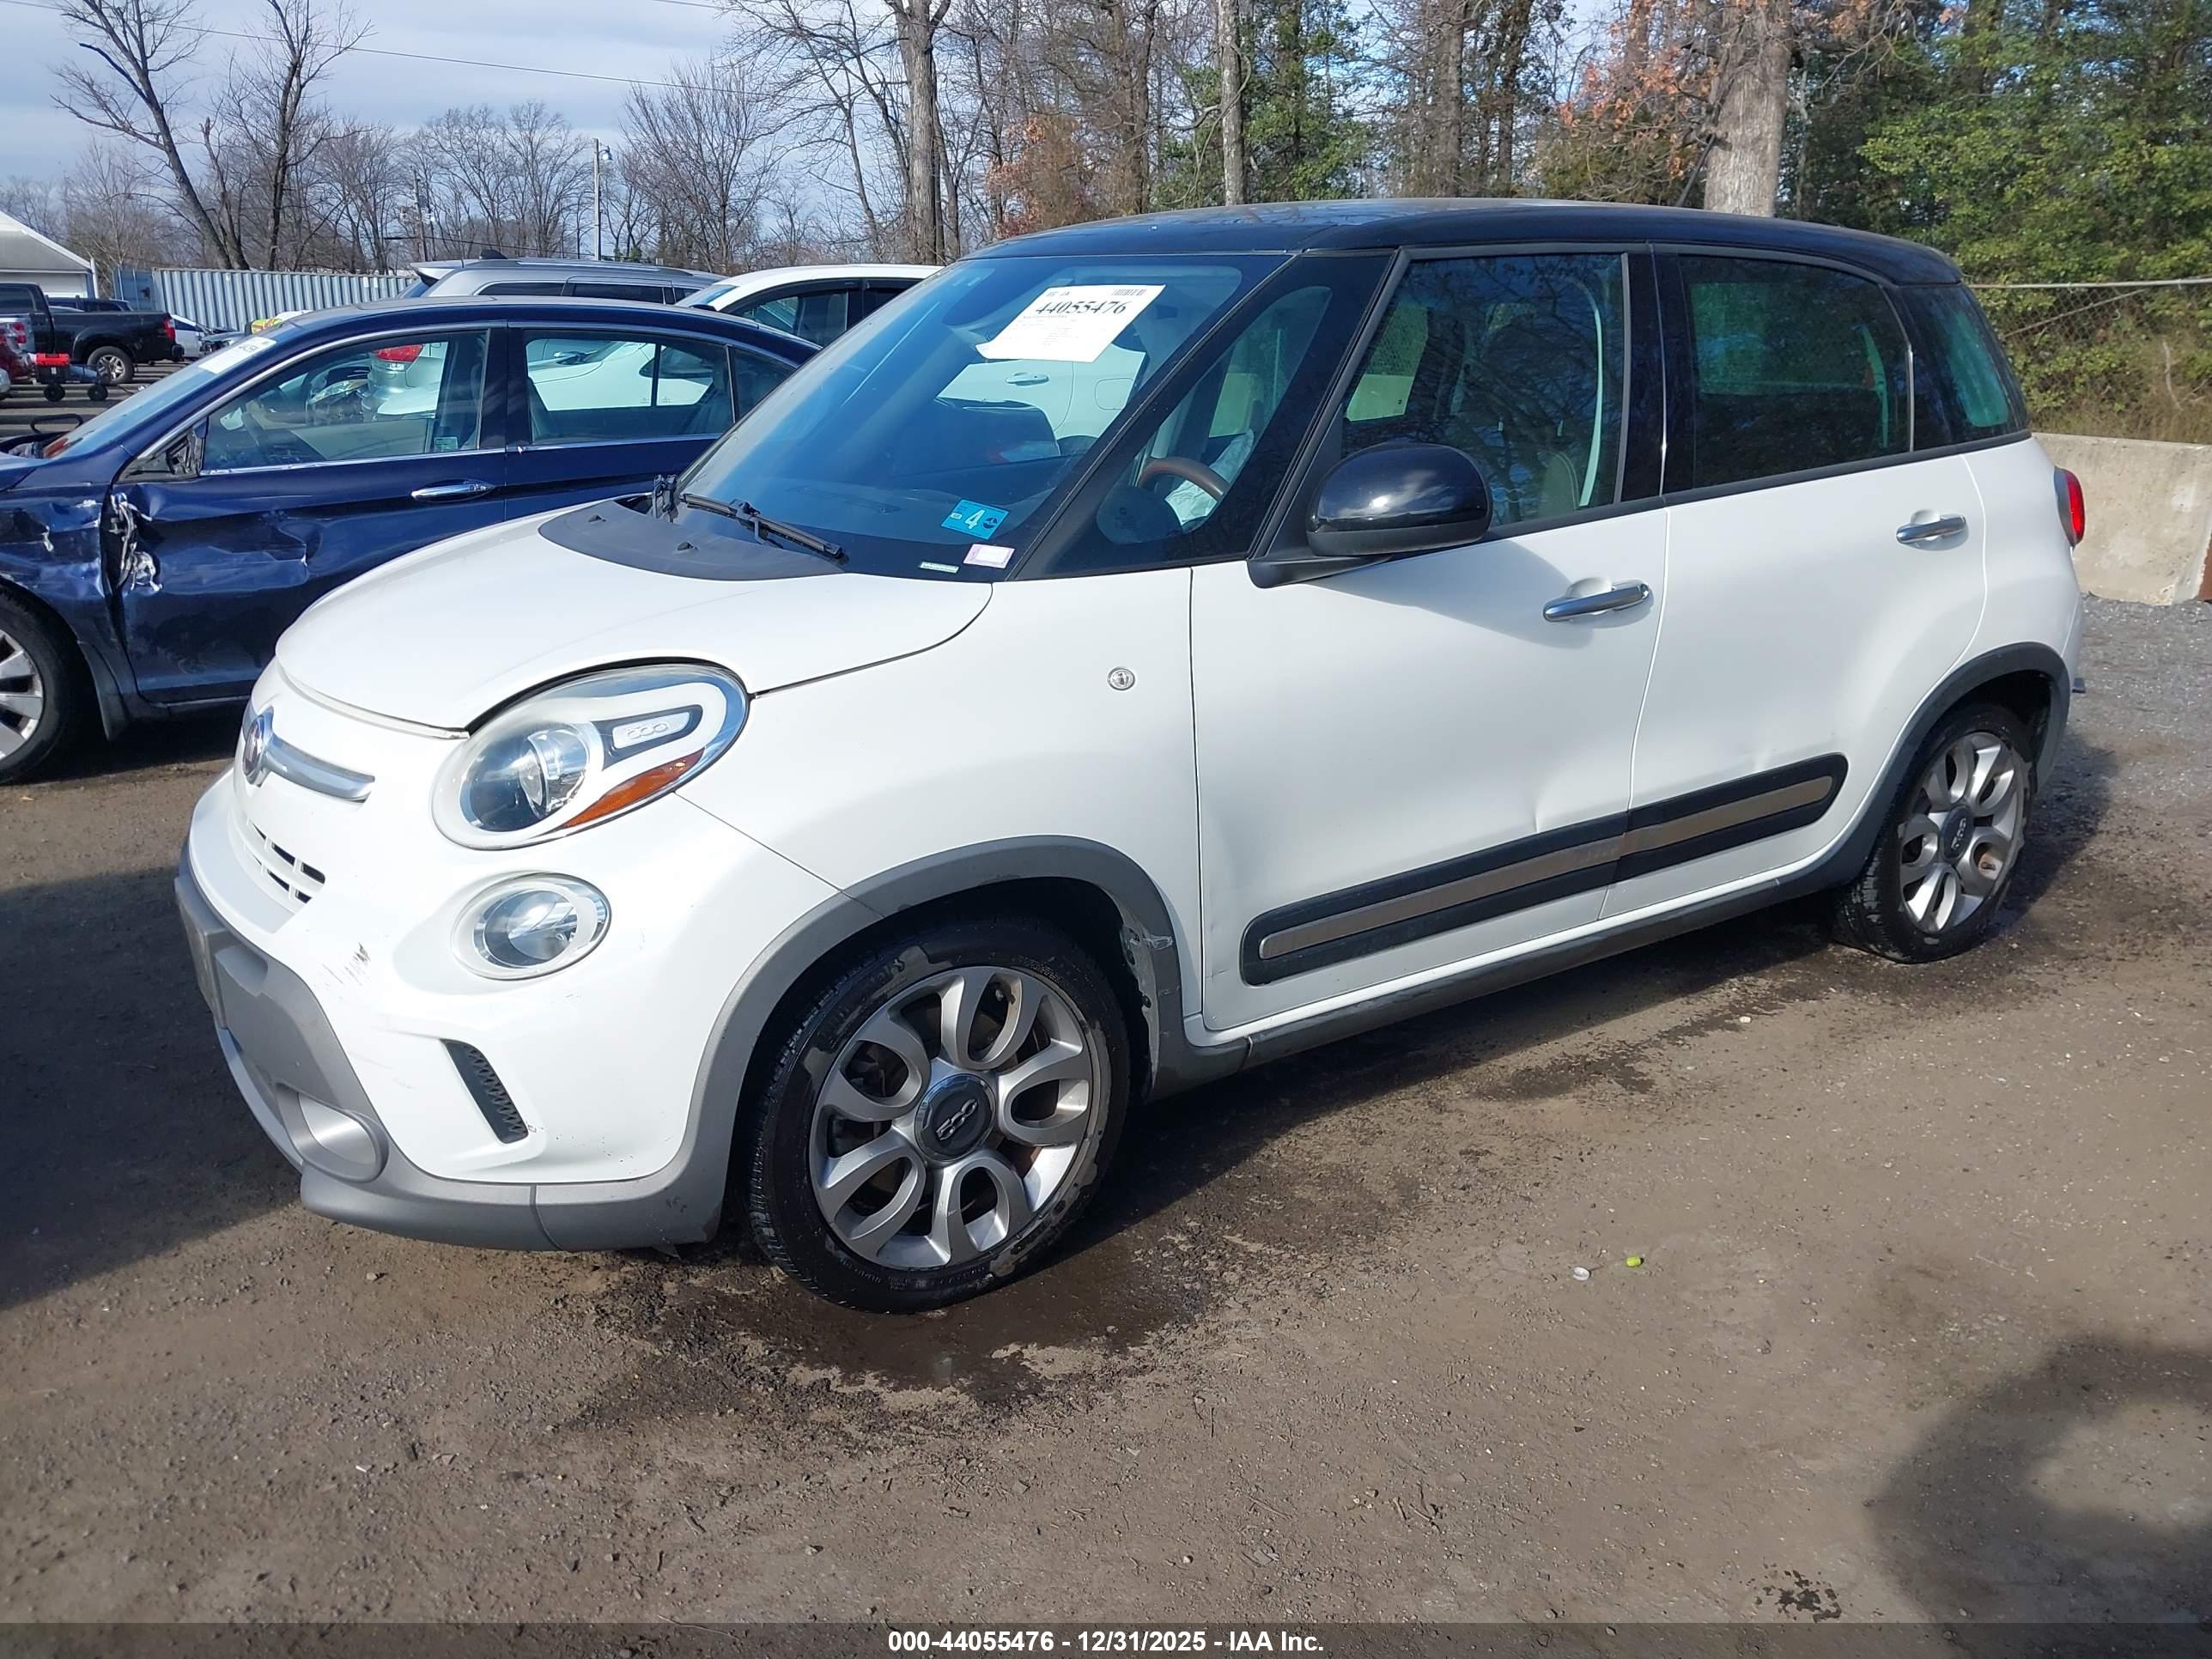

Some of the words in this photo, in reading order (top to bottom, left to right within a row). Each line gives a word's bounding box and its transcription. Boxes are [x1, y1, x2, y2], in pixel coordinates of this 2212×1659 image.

[1036, 301, 1132, 314] 44055476
[965, 508, 985, 530] 4
[936, 1098, 978, 1141] 500
